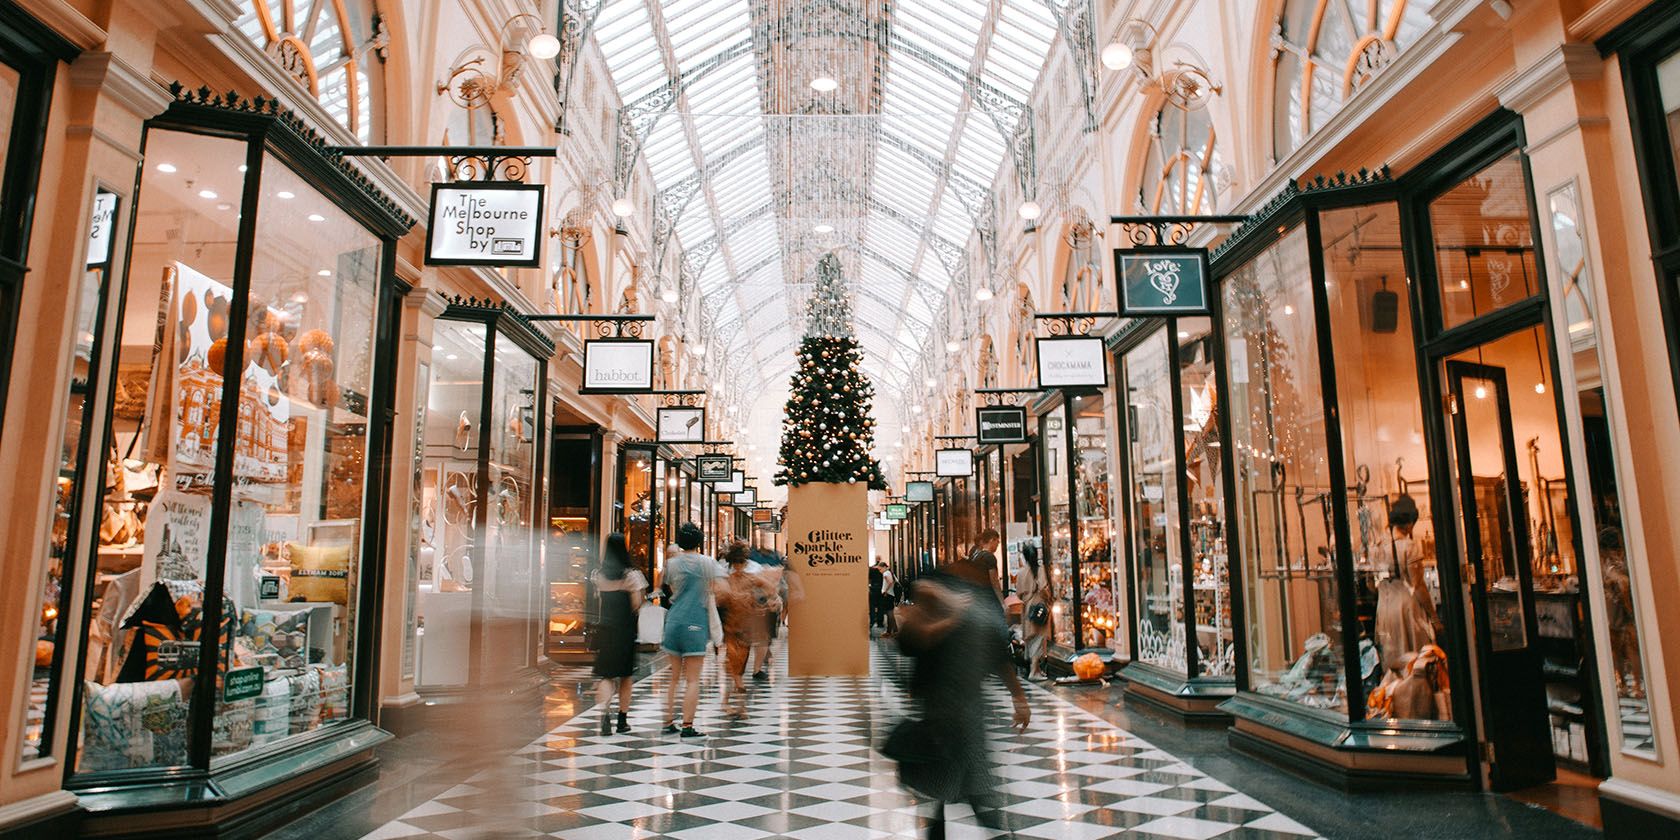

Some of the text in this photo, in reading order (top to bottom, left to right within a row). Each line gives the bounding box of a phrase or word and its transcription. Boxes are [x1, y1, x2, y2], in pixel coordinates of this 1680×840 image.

[459, 193, 487, 207] The
[442, 205, 528, 220] Melbourne
[455, 220, 496, 239] Shop
[469, 240, 489, 253] by
[807, 529, 853, 543] Glitter.
[793, 541, 844, 555] Sparkle
